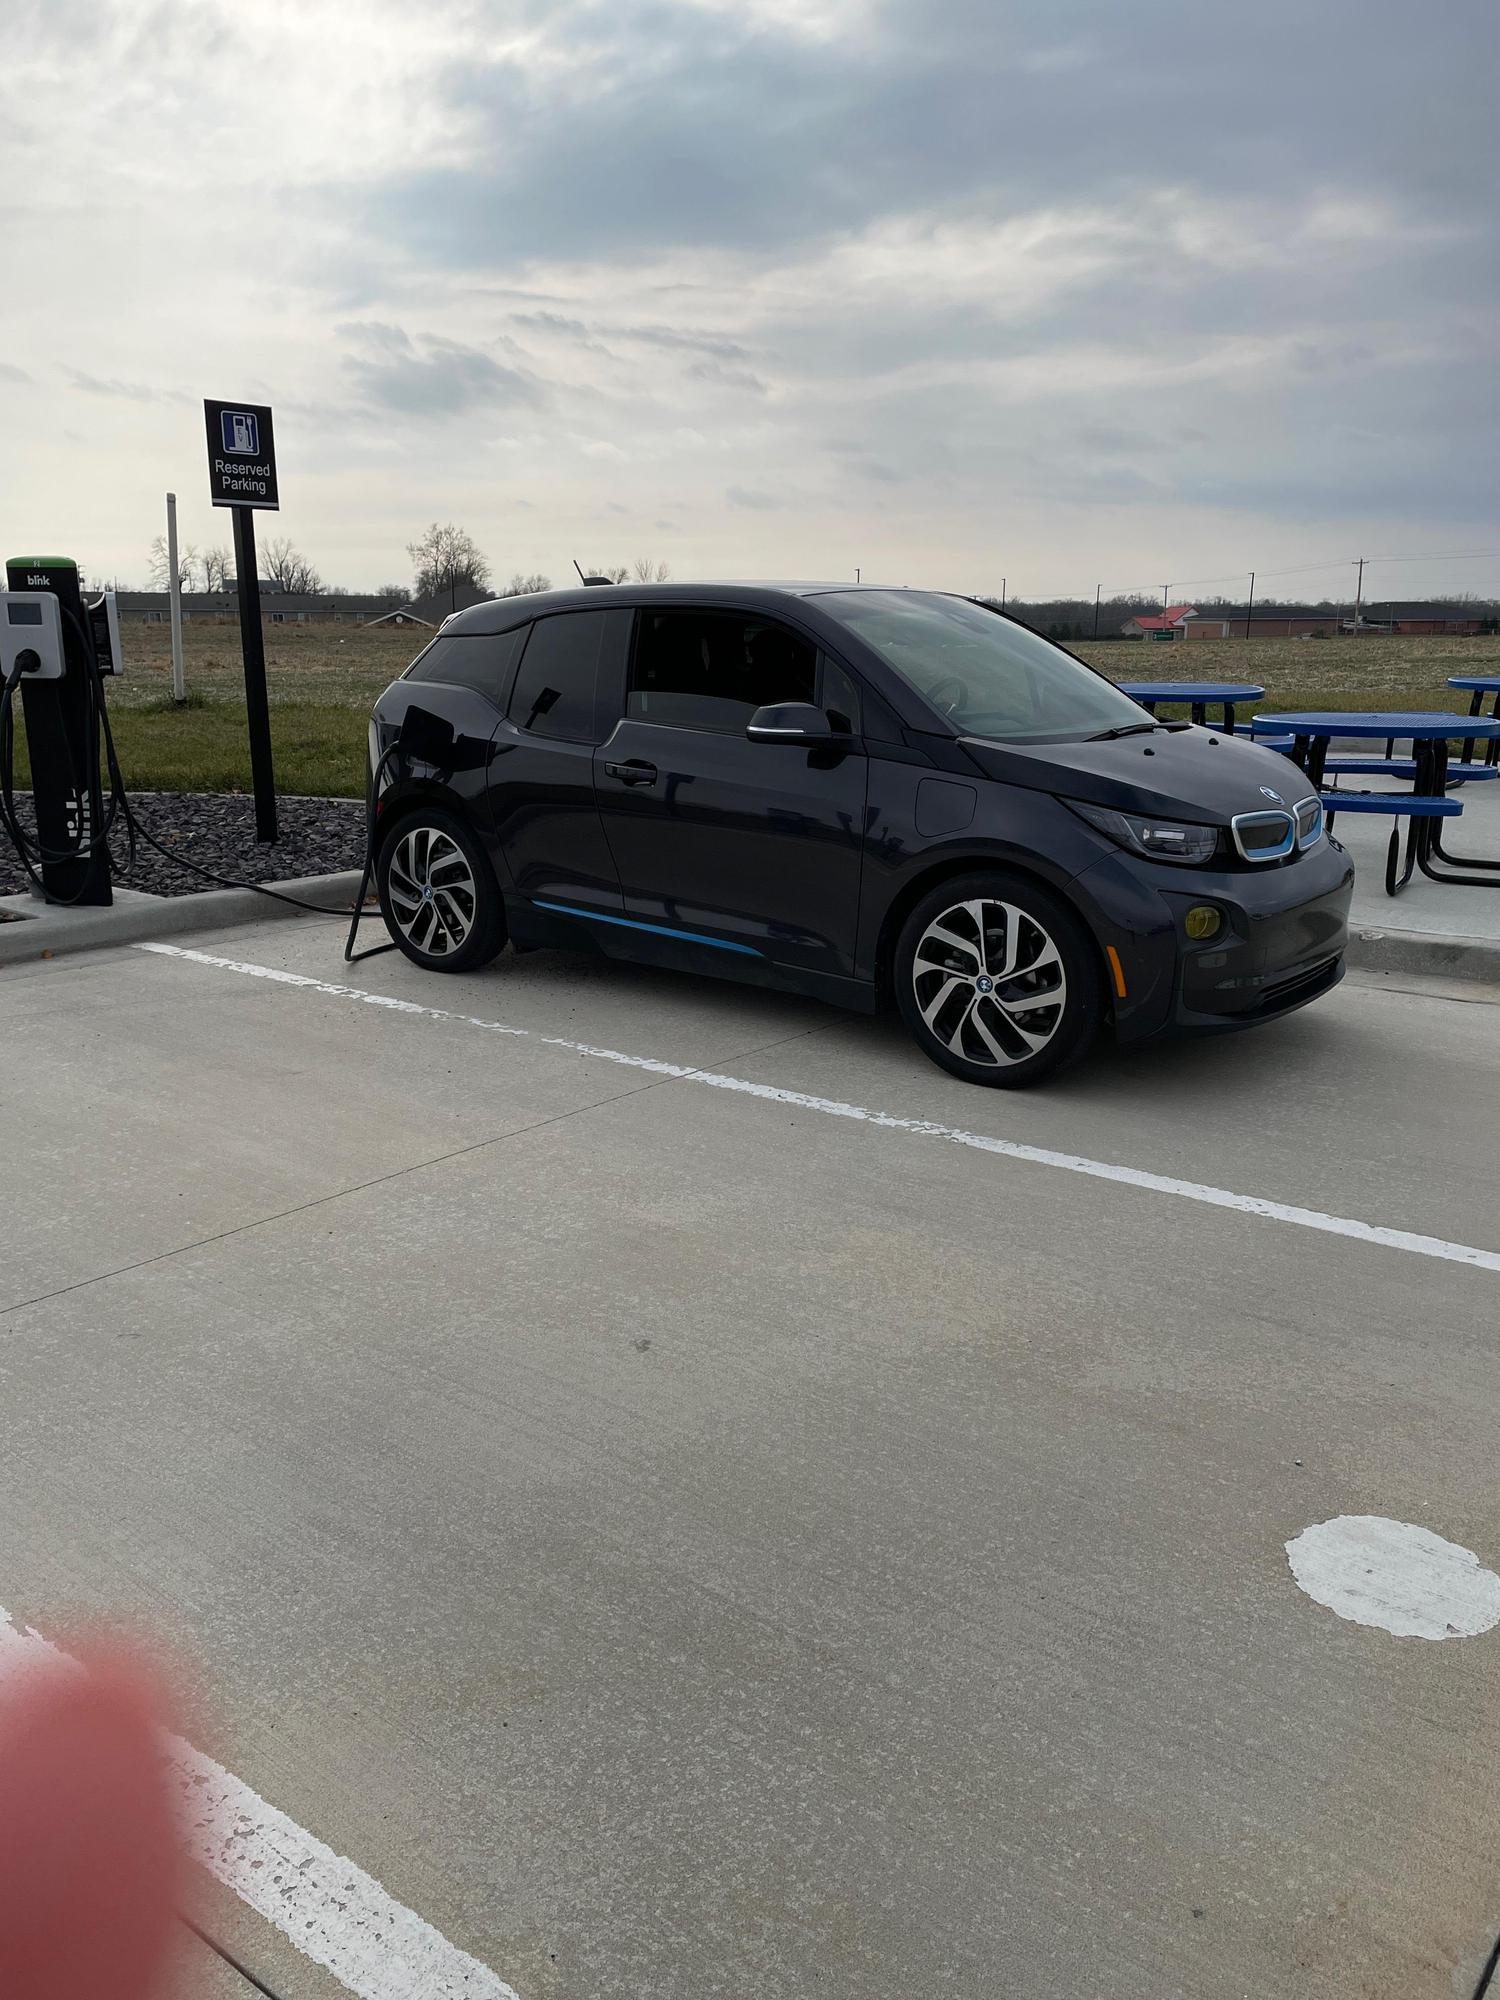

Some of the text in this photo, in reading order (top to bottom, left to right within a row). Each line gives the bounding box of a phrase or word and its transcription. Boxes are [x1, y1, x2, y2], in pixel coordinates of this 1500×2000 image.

[215, 459, 270, 477] Reserved
[222, 475, 266, 495] Parking
[27, 574, 51, 586] blink
